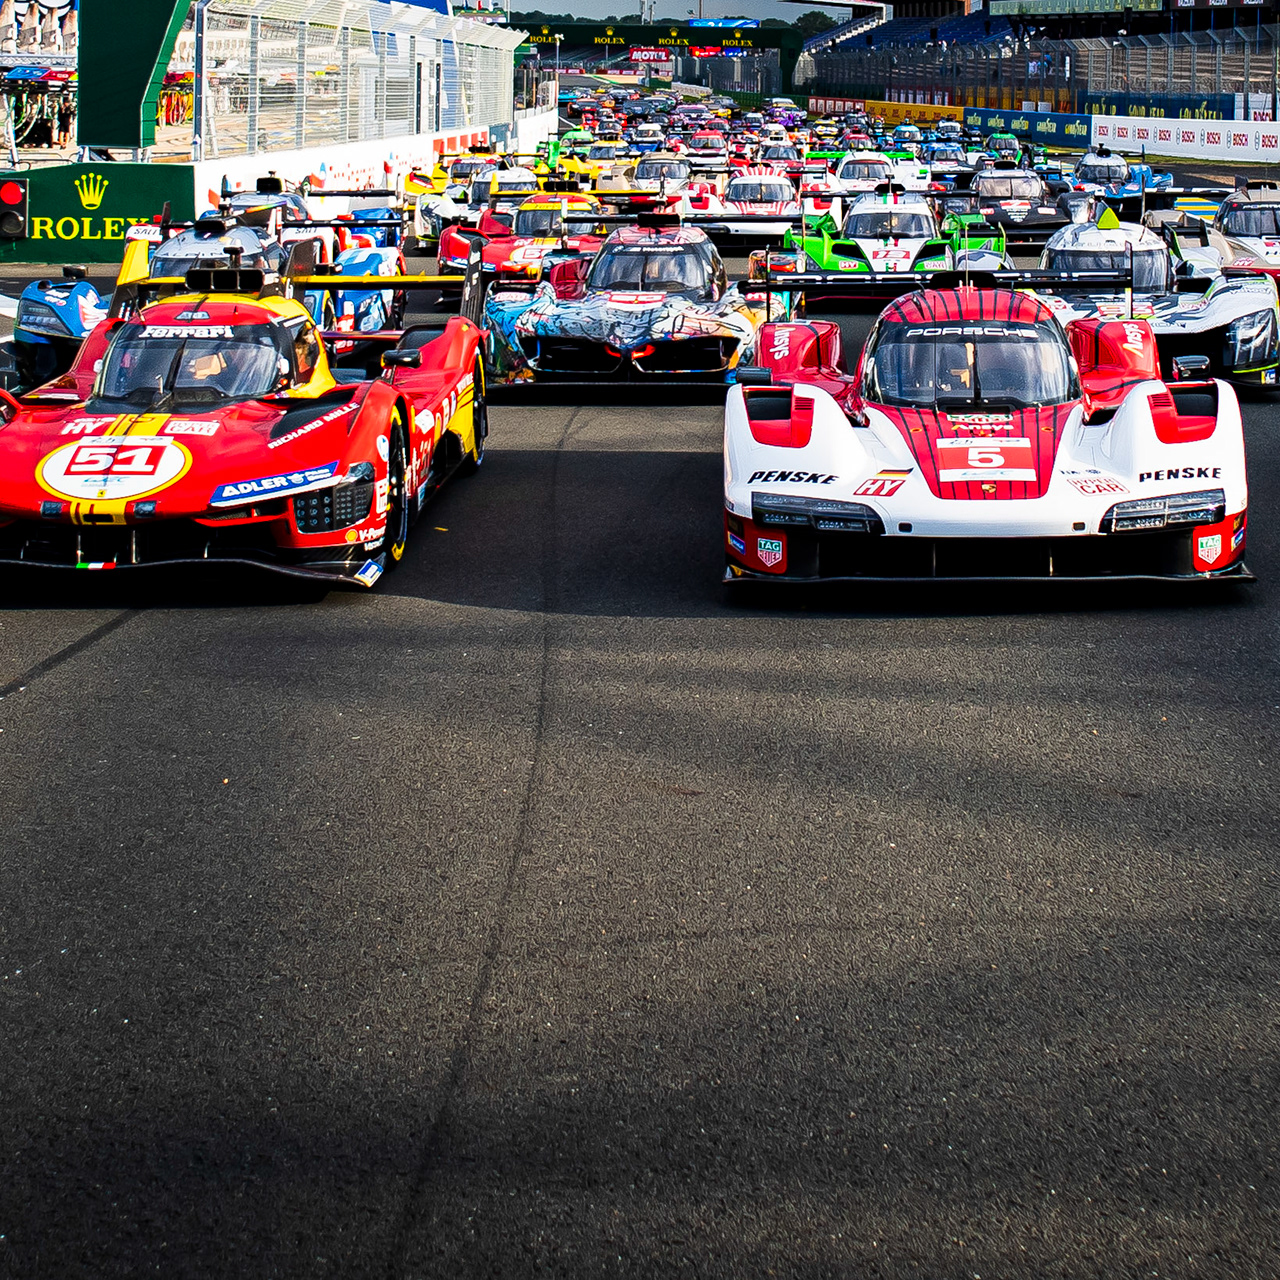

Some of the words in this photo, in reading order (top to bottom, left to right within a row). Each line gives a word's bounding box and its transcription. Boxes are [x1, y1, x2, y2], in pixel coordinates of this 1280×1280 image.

[594, 37, 625, 45] ROLEX
[658, 38, 689, 46] ROLEX
[722, 39, 753, 47] ROLEX
[1158, 129, 1171, 141] BOSCH
[1181, 130, 1195, 143] BOSCH
[1206, 132, 1221, 145] BOSCH
[1233, 133, 1248, 147] BOSCH
[1262, 134, 1278, 148] BOSCH
[139, 325, 234, 338] Ferrari
[906, 327, 1039, 338] PORSCHE
[773, 323, 791, 360] Ansys
[1122, 323, 1146, 358] Ansys
[61, 422, 109, 435] HY
[267, 420, 325, 449] RICHARD
[322, 401, 360, 425] MILLE
[71, 447, 155, 472] 51
[967, 448, 1005, 467] 5
[747, 470, 840, 485] PENSKE
[1139, 467, 1222, 482] PENSKE
[221, 475, 289, 497] ADLER
[859, 480, 897, 495] HY
[1079, 483, 1122, 494] CAR
[760, 539, 780, 550] TAG
[1200, 537, 1221, 548] TAG
